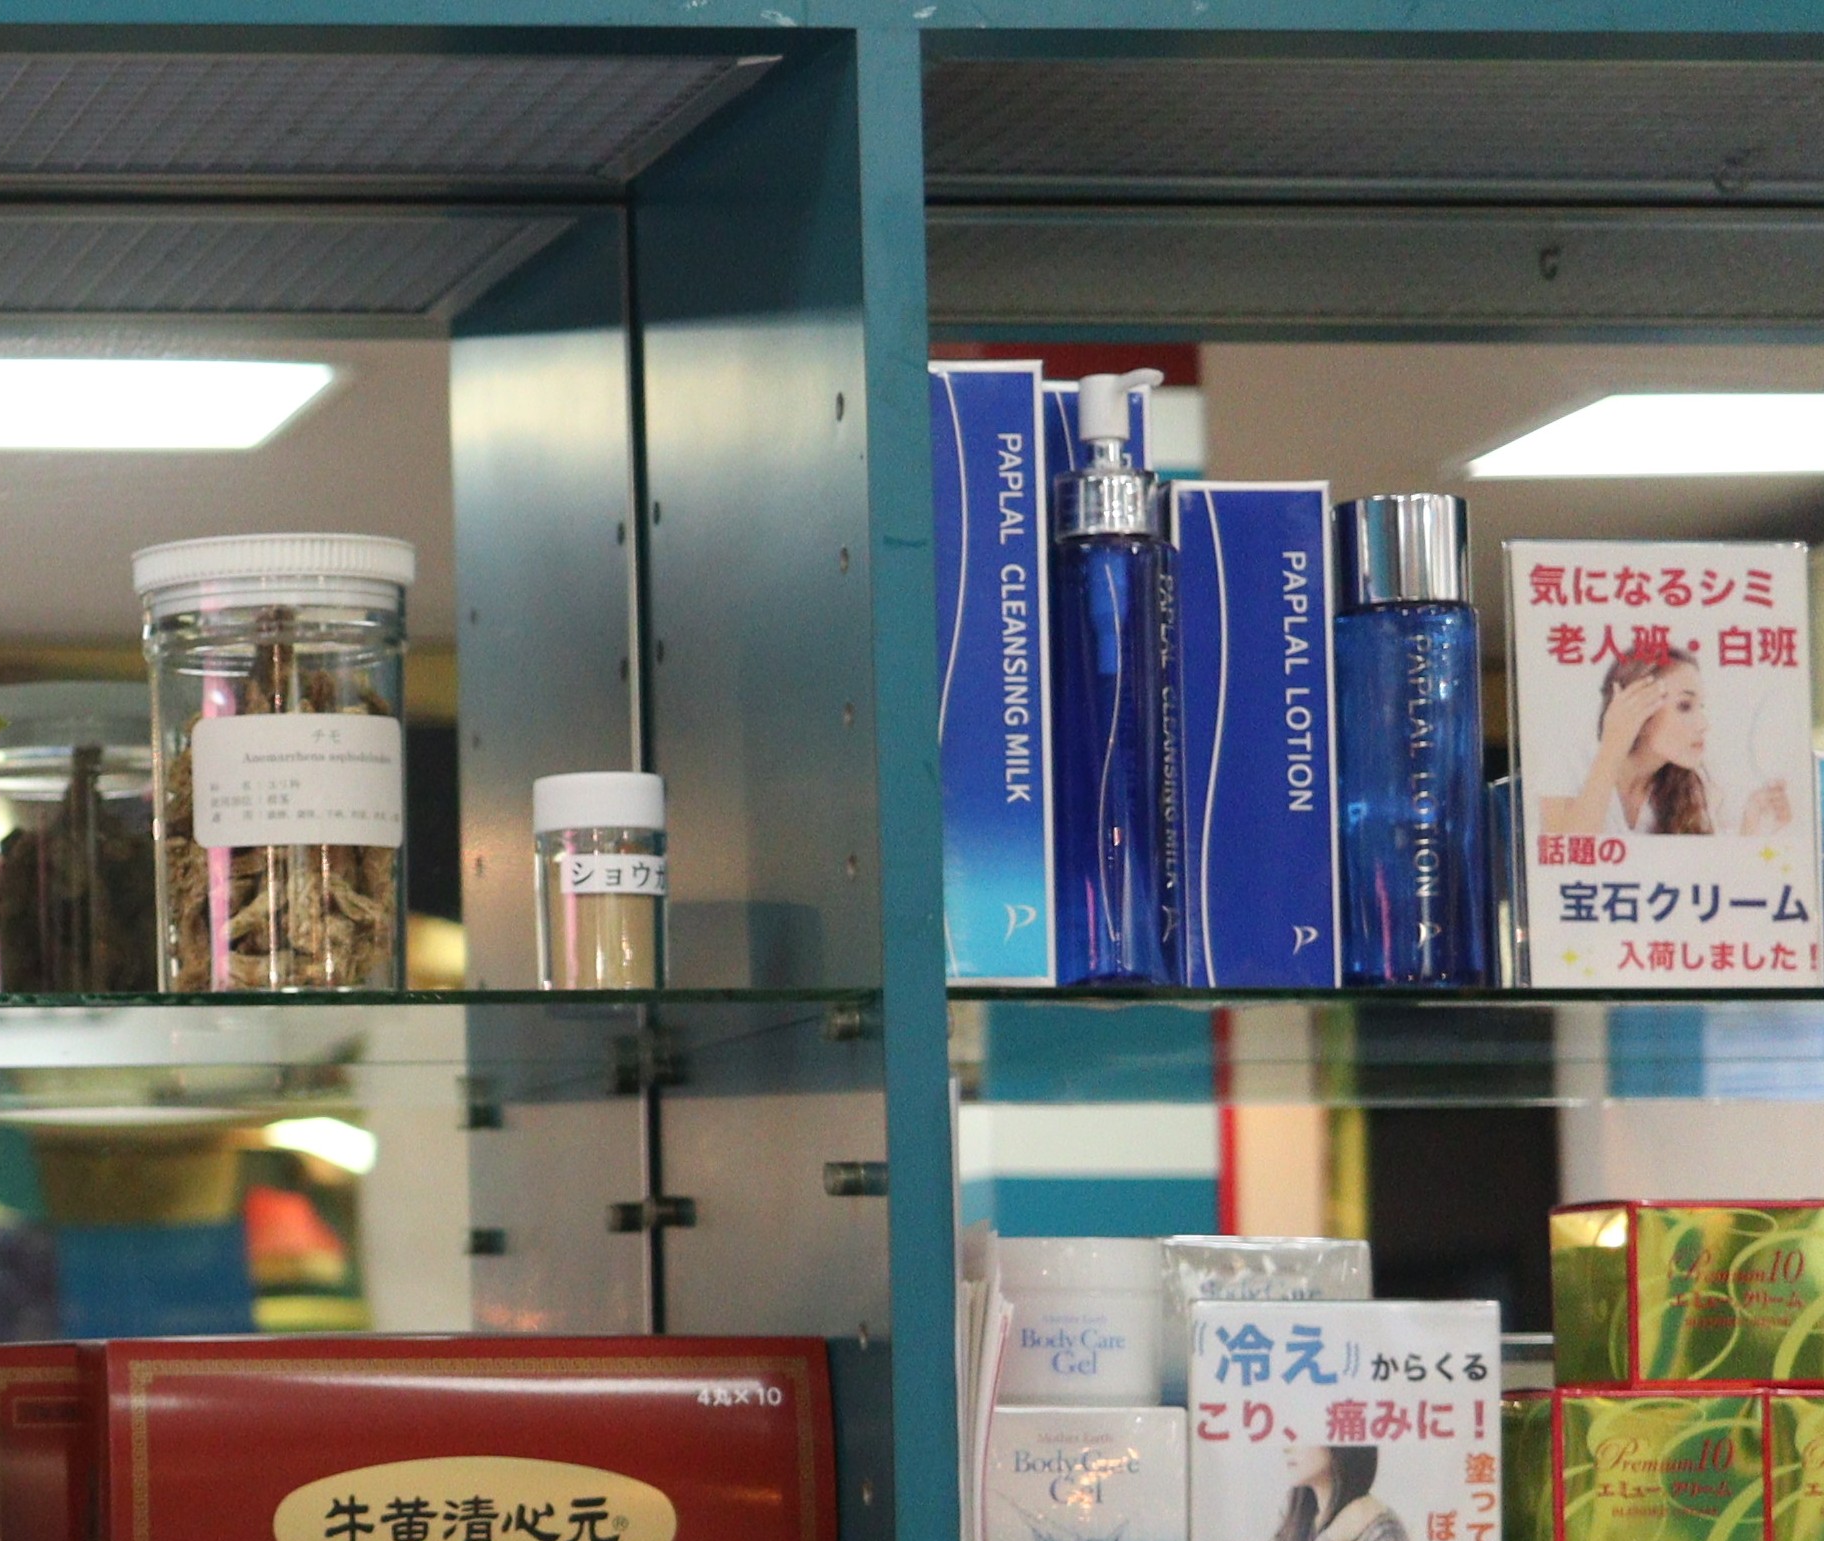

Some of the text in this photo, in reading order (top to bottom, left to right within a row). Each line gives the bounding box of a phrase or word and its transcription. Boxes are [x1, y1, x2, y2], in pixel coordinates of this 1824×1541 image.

[1529, 563, 1775, 609] 気になるシミ
[997, 432, 1033, 803] PAPLAL CLEANSING MILK
[1282, 549, 1313, 812] PAPLAL LOTION
[1537, 836, 1627, 867] 話題の
[1559, 882, 1809, 923] 宝石クリーム
[1617, 940, 1819, 971] 入荷しました！
[1020, 1329, 1127, 1352] Body Care
[1214, 1323, 1489, 1386] 冷え からくる
[1051, 1350, 1099, 1376] Gel
[1197, 1399, 1488, 1443] こり、痛みに！
[1013, 1451, 1074, 1476] Body
